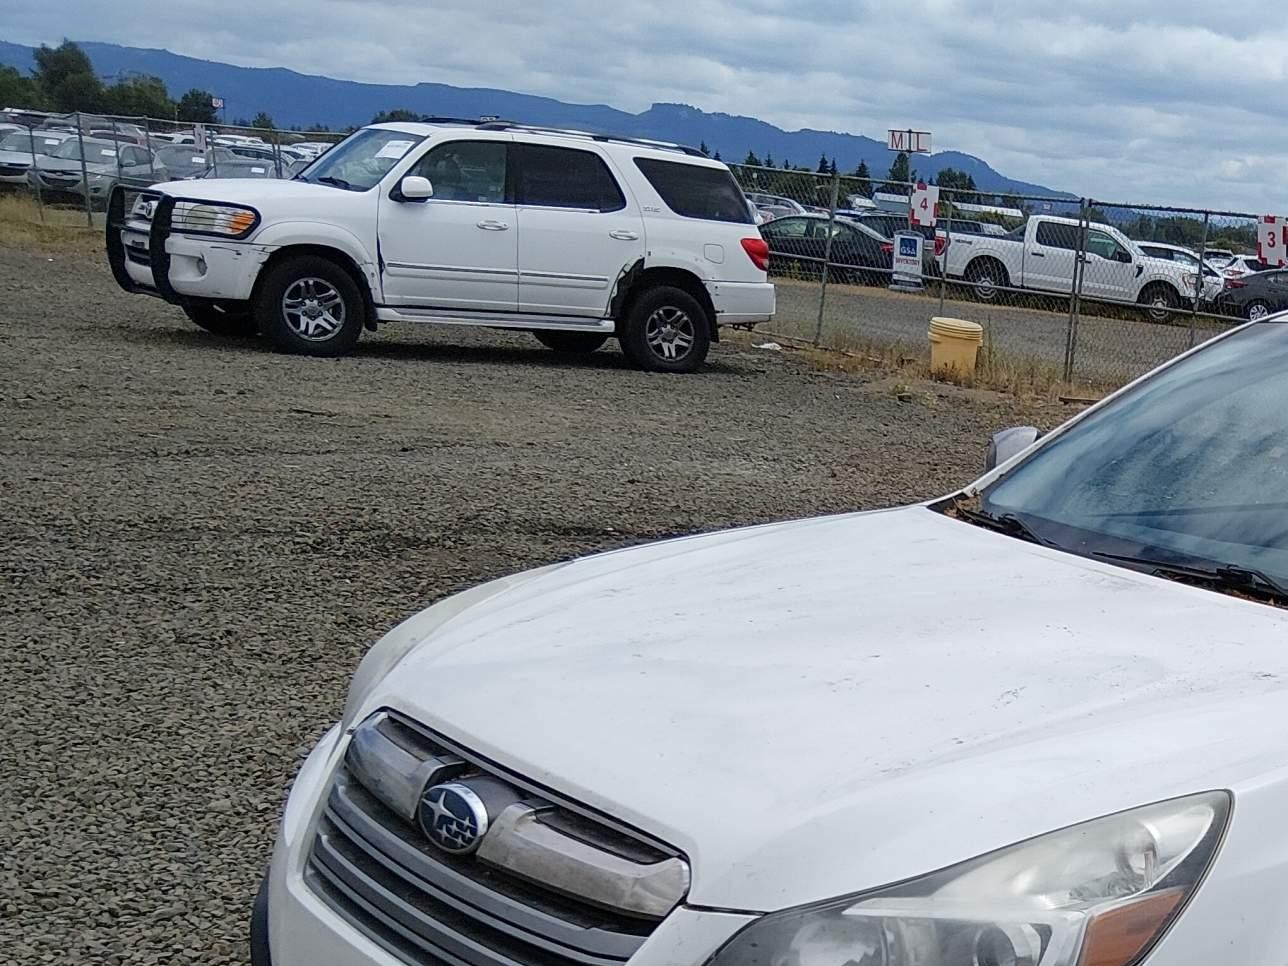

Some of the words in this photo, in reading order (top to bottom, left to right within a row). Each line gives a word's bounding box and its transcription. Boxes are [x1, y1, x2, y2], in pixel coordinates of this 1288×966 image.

[920, 197, 928, 210] 4
[1267, 231, 1276, 248] 3
[900, 246, 916, 255] GSA
